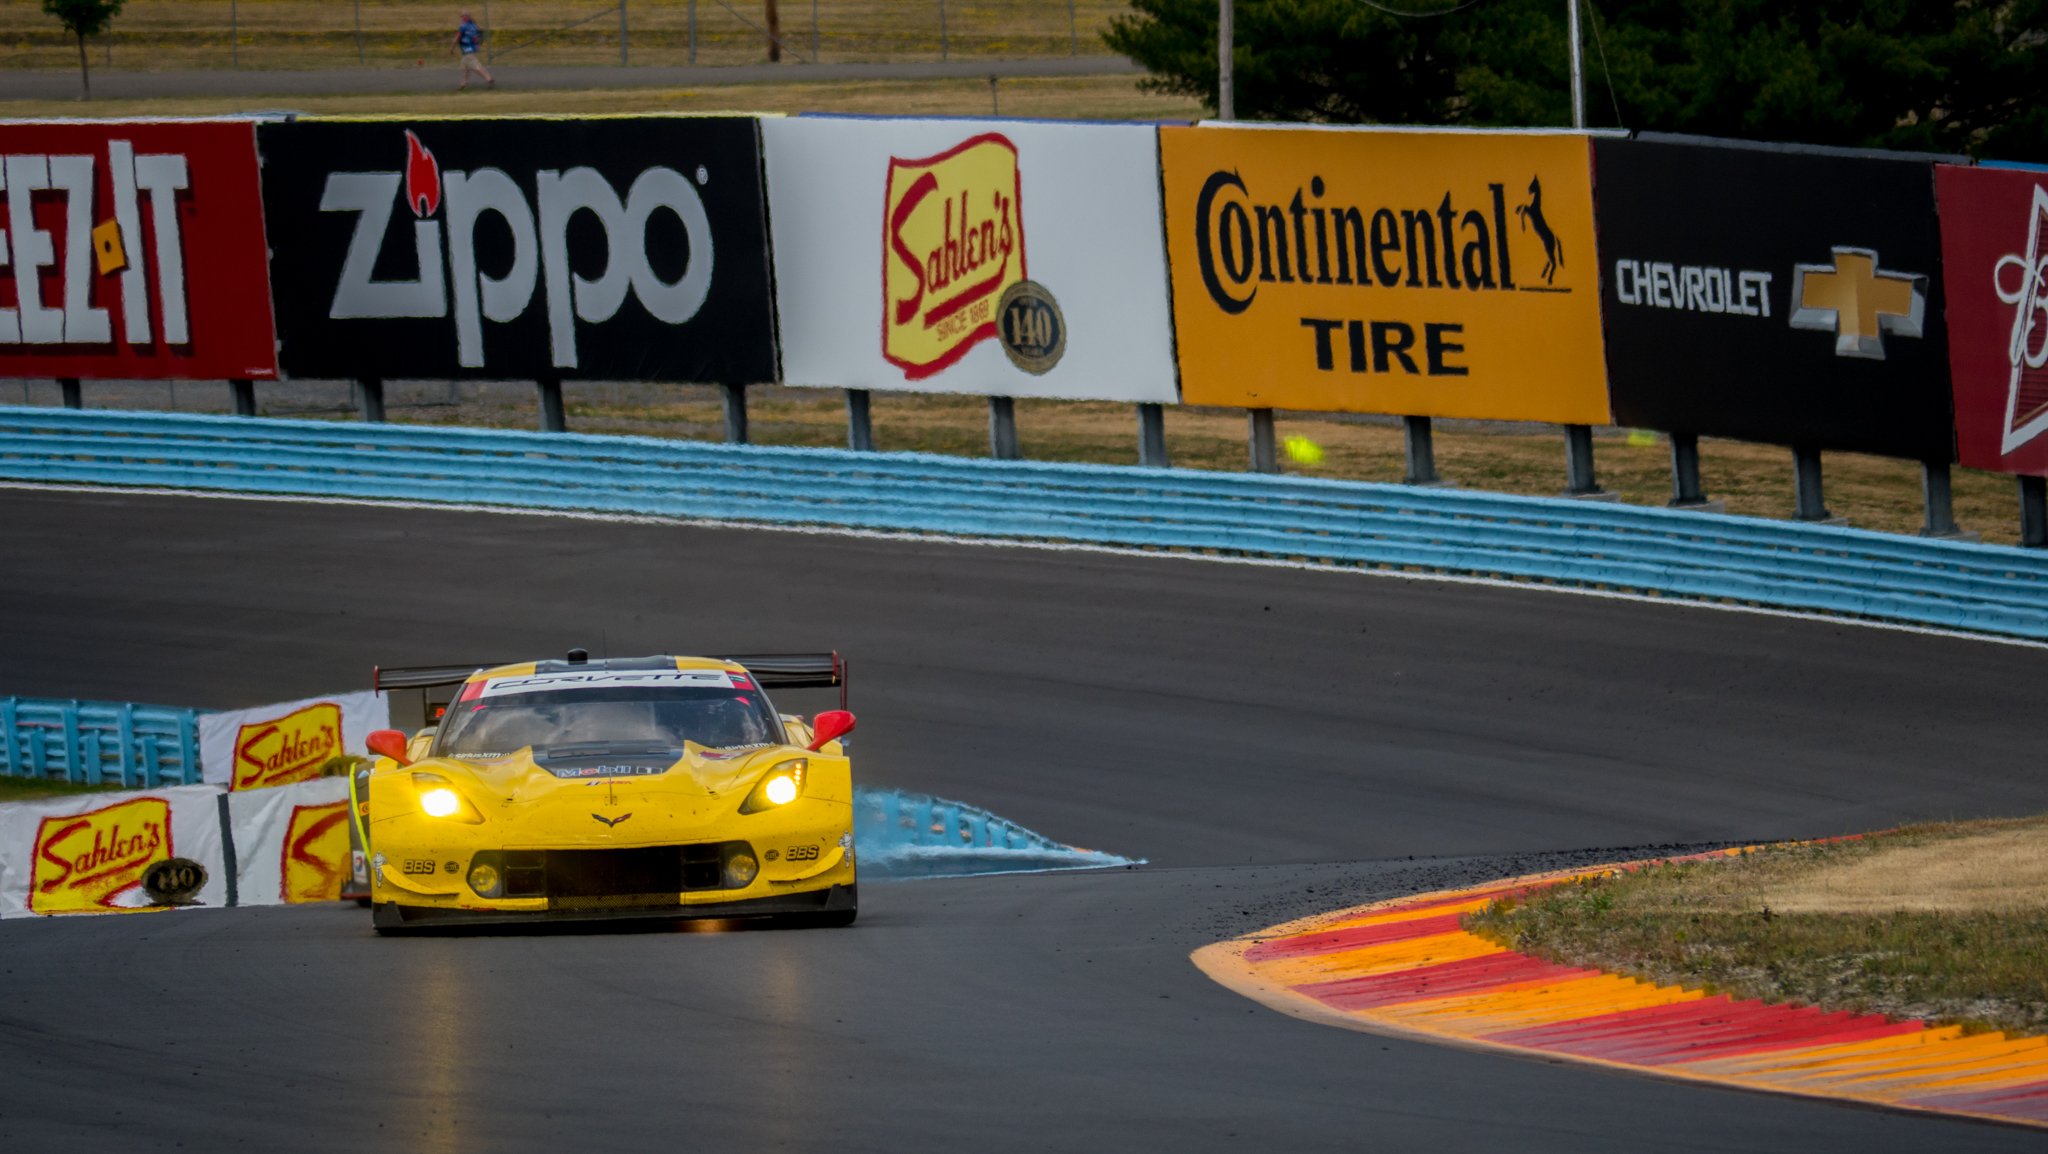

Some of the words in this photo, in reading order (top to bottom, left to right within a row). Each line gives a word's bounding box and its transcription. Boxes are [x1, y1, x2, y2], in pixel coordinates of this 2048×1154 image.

[890, 171, 1015, 326] Sahlen's
[1196, 166, 1516, 316] Continental
[1615, 259, 1773, 318] CHEVROLET
[936, 310, 968, 342] SINCE
[1009, 306, 1052, 348] 140
[1300, 317, 1469, 376] TIRE
[490, 673, 724, 690] CORVETTE
[239, 724, 335, 788] Sahlen's
[556, 765, 632, 778] Mobil
[40, 819, 161, 894] Sahlen's
[403, 859, 436, 875] BBS
[786, 844, 820, 862] BBS
